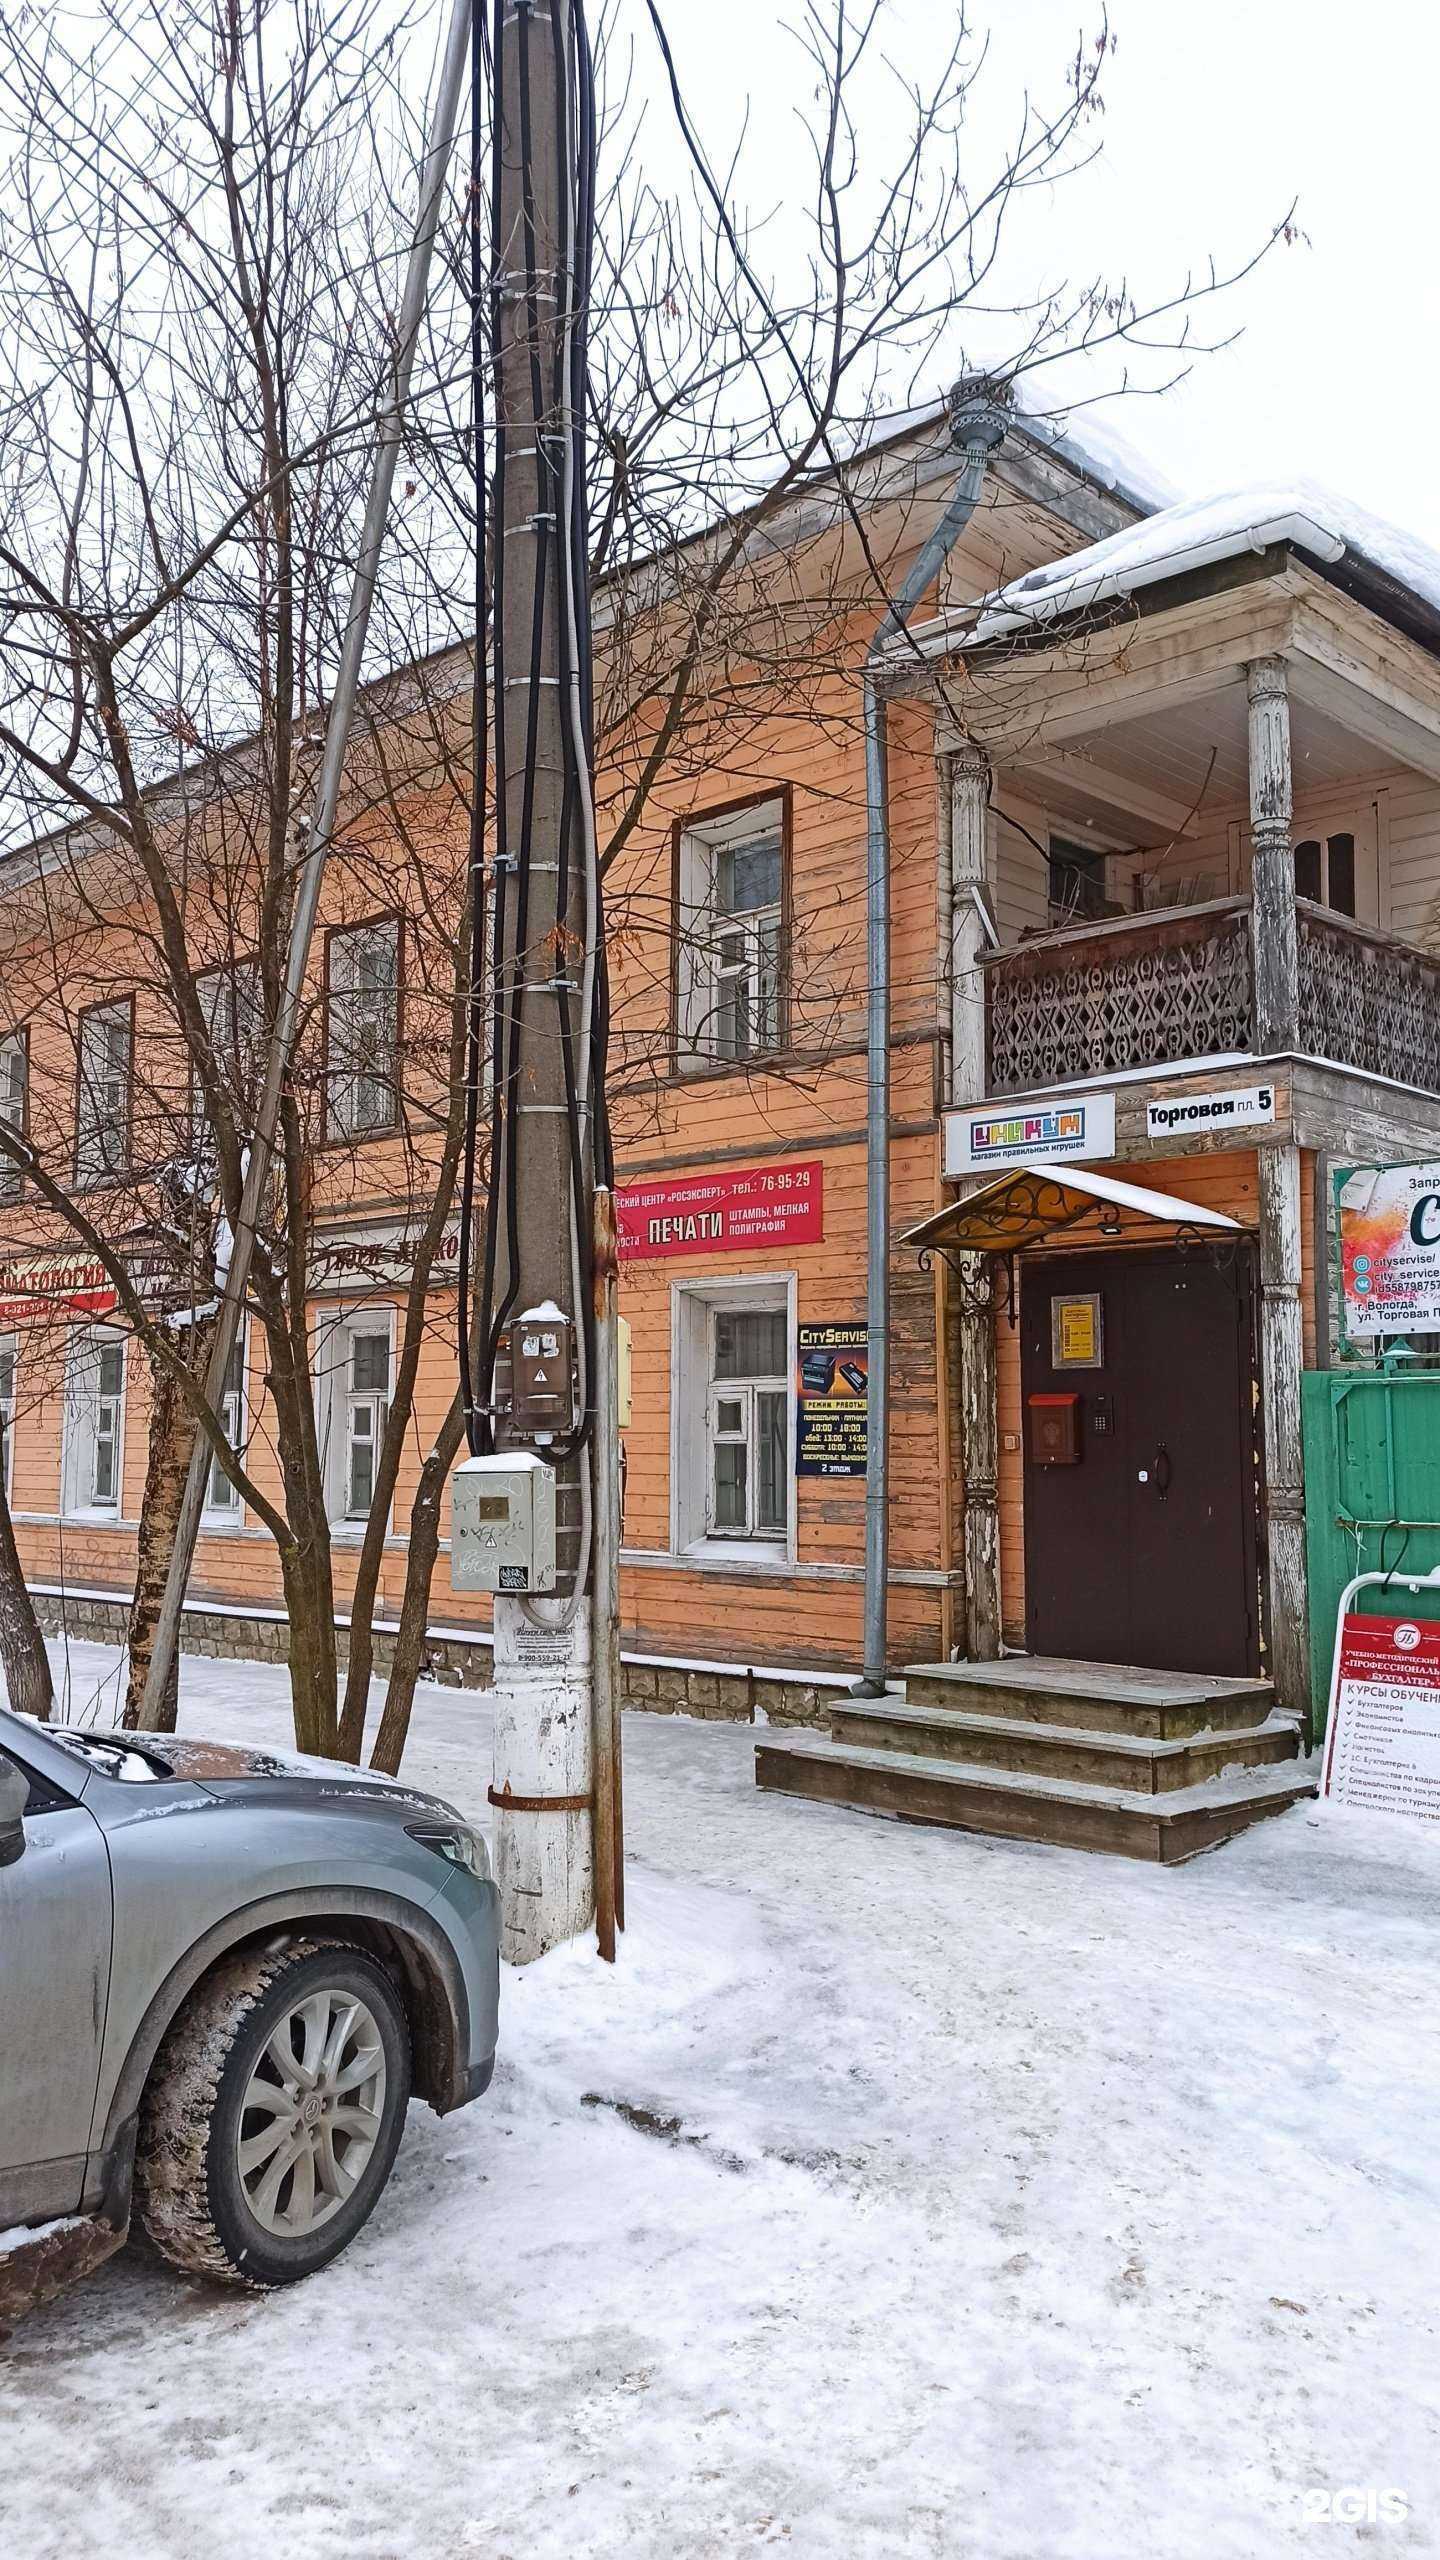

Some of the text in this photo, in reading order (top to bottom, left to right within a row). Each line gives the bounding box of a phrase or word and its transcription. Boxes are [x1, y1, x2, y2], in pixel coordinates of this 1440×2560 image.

[1149, 1101, 1235, 1128] Торговая
[1258, 1090, 1272, 1110] 5
[975, 1114, 1080, 1147] УНИКУМ
[971, 1141, 1085, 1161] магазин правильных игрушек
[641, 1193, 666, 1207] ЦЕНТР
[761, 1171, 810, 1192] 76-95-29
[729, 1202, 809, 1221] ШТАМПЫ, МЕЛКАЯ
[648, 1211, 723, 1245] ПЕЧАТИ
[729, 1220, 786, 1235] ПОЛИГРАФИЯ
[1367, 1300, 1418, 1311] Вологда,
[1357, 1313, 1375, 1323] ул.
[1378, 1310, 1429, 1321] Торговая
[811, 1423, 833, 1432] 10:00
[821, 1463, 828, 1472] 2
